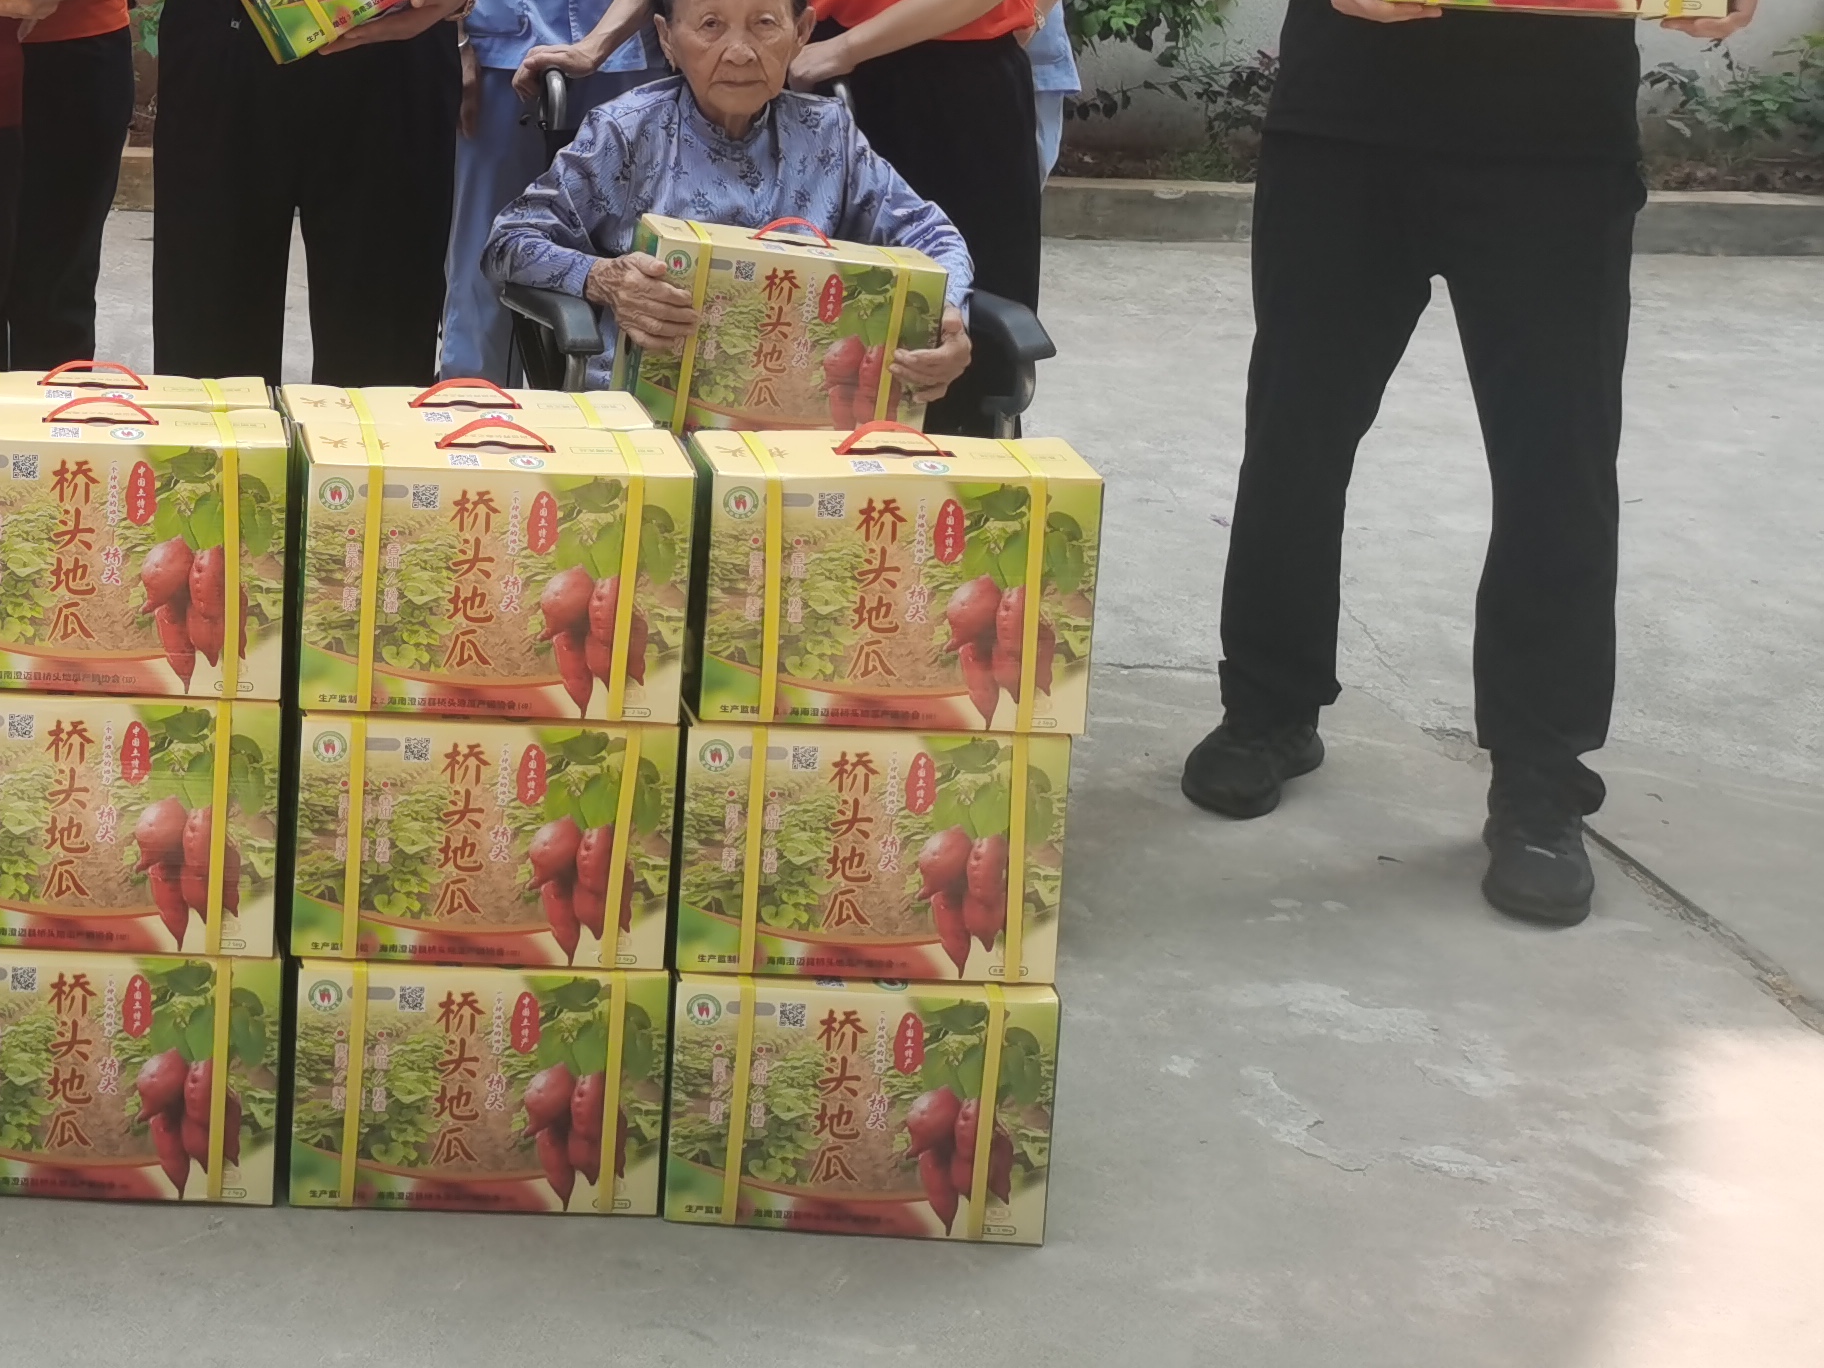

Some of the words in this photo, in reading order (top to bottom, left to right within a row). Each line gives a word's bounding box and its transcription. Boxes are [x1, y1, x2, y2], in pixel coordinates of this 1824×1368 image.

[744, 267, 803, 410] 桥头地瓜
[136, 465, 146, 520] 中国土特产
[537, 495, 549, 549] 中国土特产
[943, 504, 956, 559] 中国土特产
[47, 459, 100, 643] 桥头地瓜
[102, 547, 121, 584] 桥头
[443, 489, 502, 669] 桥头地瓜
[501, 576, 521, 612] 桥头
[847, 498, 909, 680] 桥头地瓜
[906, 586, 927, 621] 桥头
[42, 719, 95, 900] 桥头地瓜
[97, 806, 115, 842] 桥头
[433, 742, 492, 917] 桥头地瓜
[490, 826, 510, 861] 桥头
[822, 751, 880, 928] 桥头地瓜
[879, 836, 899, 871] 桥头
[45, 972, 97, 1150] 桥头地瓜
[99, 1058, 117, 1093] 桥头
[431, 991, 486, 1165] 桥头地瓜
[486, 1075, 505, 1109] 桥头
[809, 1008, 869, 1185] 桥头地瓜
[867, 1094, 887, 1129] 桥头
